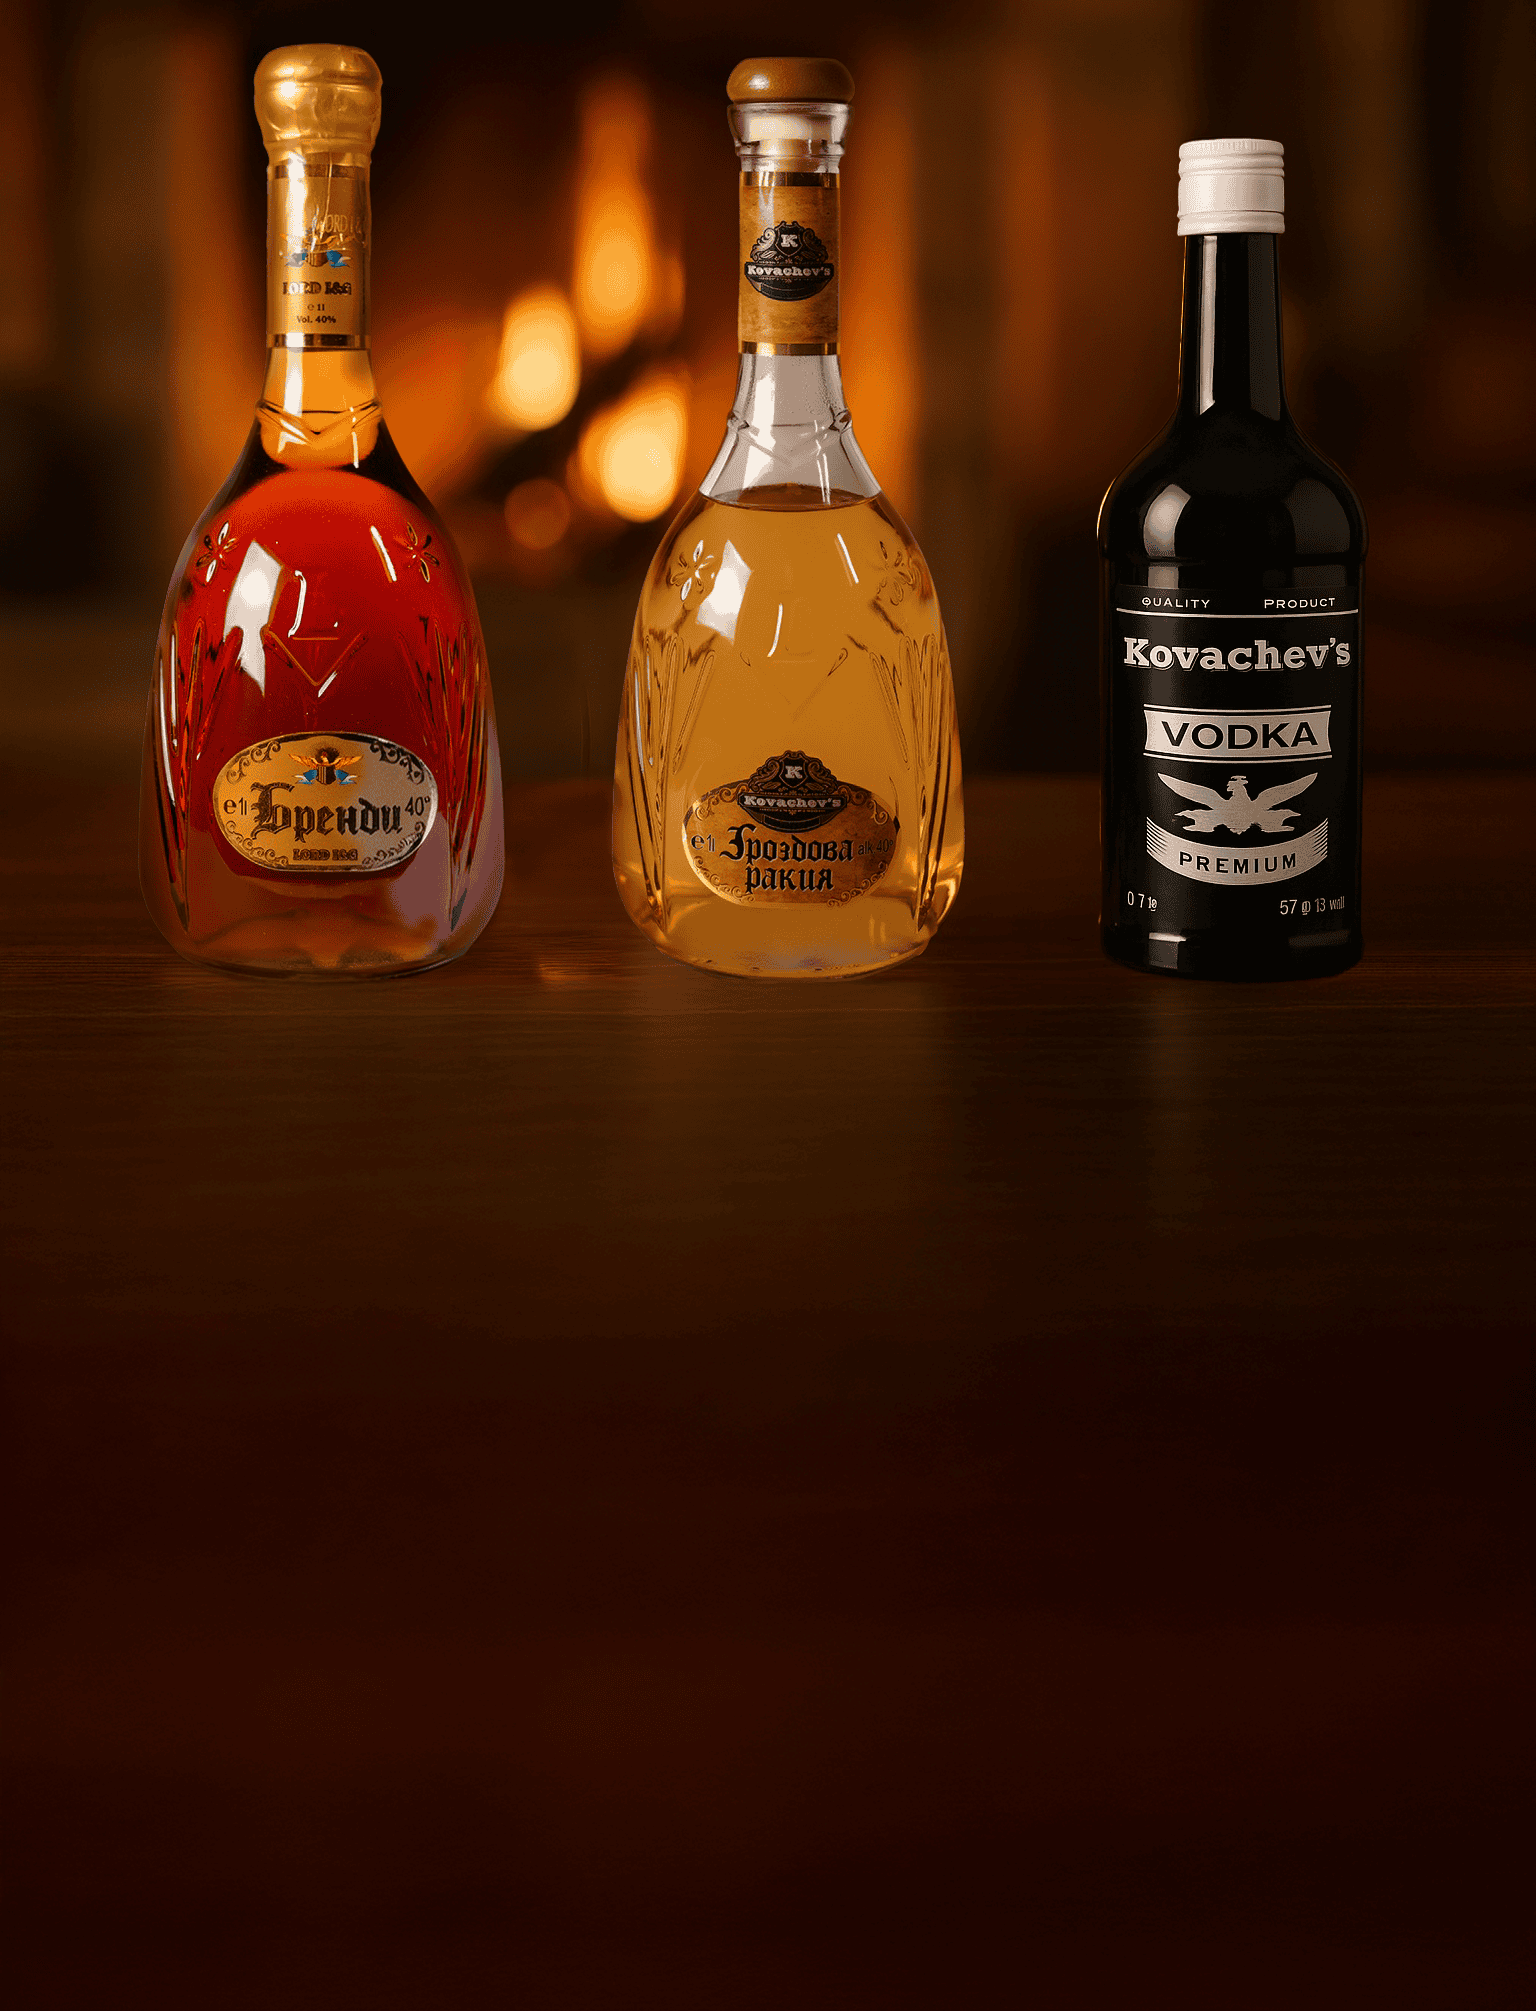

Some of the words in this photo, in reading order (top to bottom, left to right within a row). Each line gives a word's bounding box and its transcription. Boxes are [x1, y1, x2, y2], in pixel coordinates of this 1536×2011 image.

[780, 234, 798, 248] K
[747, 264, 831, 277] Kovachev's
[315, 315, 337, 324] 40%
[1141, 596, 1211, 609] QUALITY
[1263, 597, 1336, 609] PRODUCT
[1123, 637, 1351, 672] Kovachev's
[1161, 720, 1319, 750] VODKA
[784, 765, 803, 779] K
[743, 794, 842, 809] Kovachev's
[250, 782, 403, 844] Бренди
[719, 823, 855, 866] Гроздова
[1179, 852, 1297, 875] PREMIUM
[744, 866, 835, 895] ракия
[1279, 899, 1298, 916] 57
